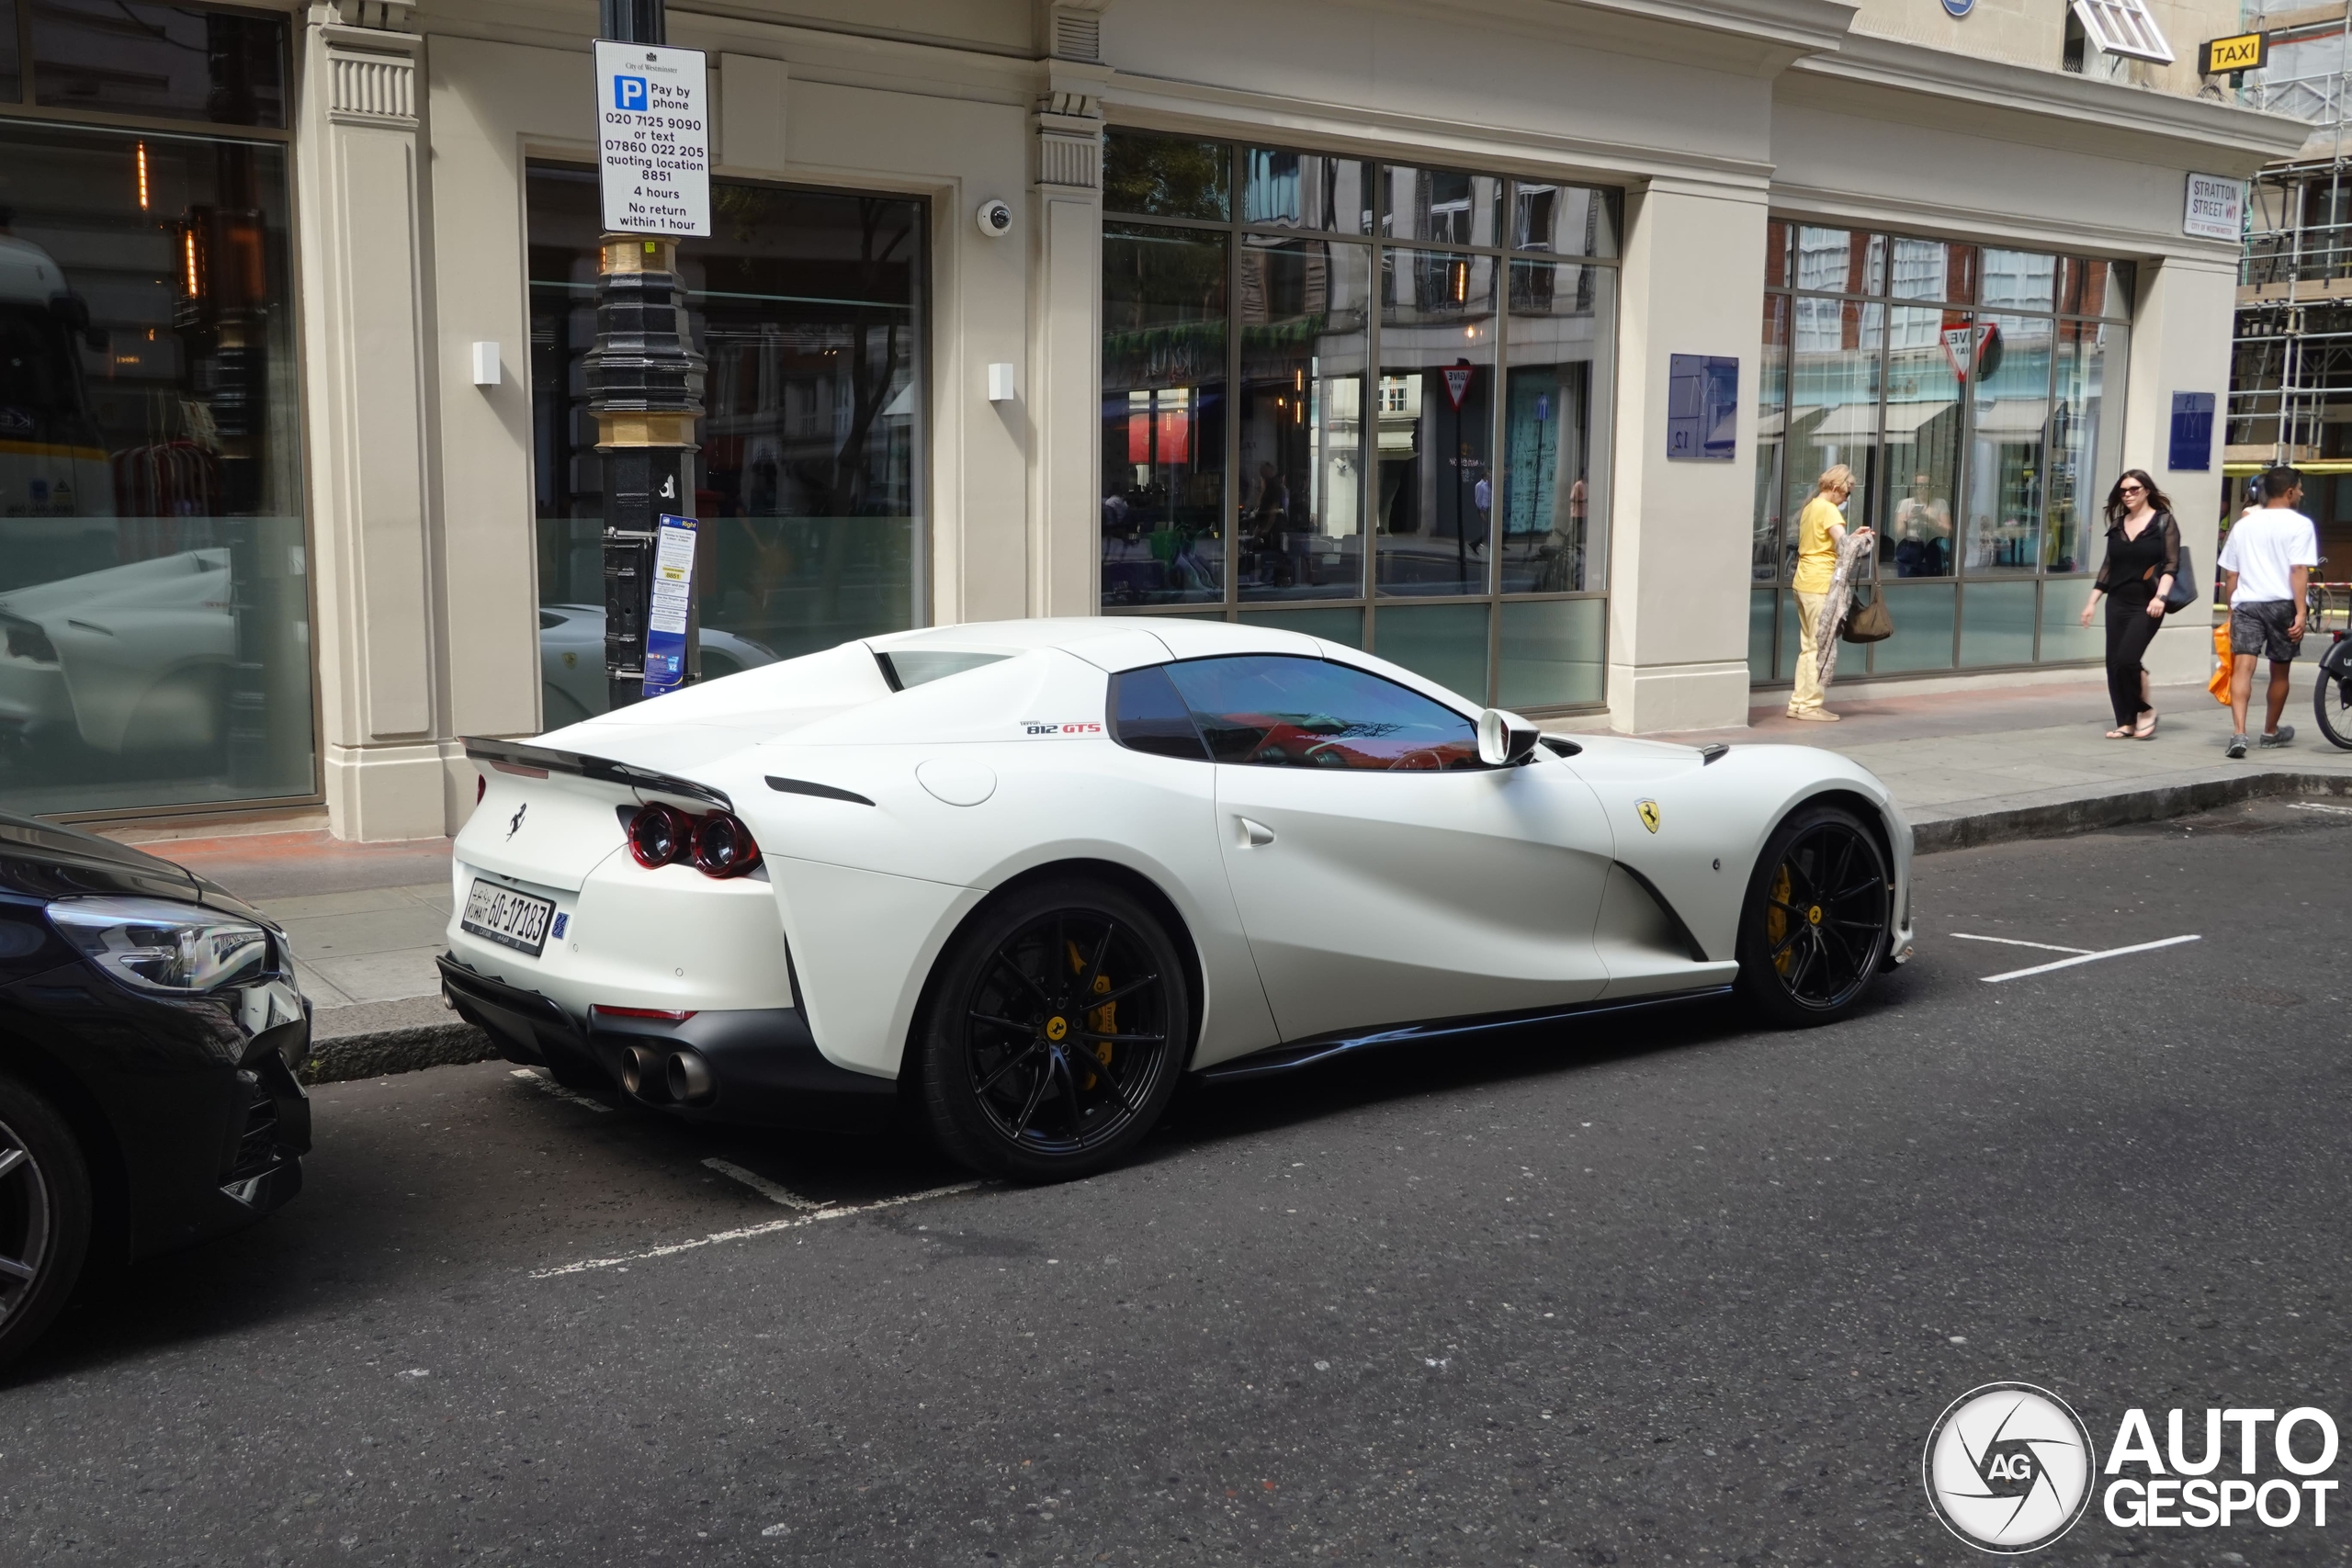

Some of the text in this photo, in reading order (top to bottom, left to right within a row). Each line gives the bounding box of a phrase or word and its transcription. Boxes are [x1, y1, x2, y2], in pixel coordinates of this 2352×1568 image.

[2213, 42, 2256, 64] TAXI
[626, 62, 637, 72] City
[645, 64, 678, 73] Westminster
[651, 84, 690, 98] Pay by
[653, 98, 689, 110] phone
[605, 112, 701, 130] 020 7125 9090
[650, 130, 675, 142] text
[605, 140, 704, 158] 07860 022 205
[606, 155, 704, 171] quoting location
[642, 170, 671, 182] 8851
[634, 186, 680, 199] 4 hours
[2195, 181, 2237, 201] STRATTON
[629, 202, 686, 216] No return
[2193, 199, 2237, 220] STREET W1
[619, 216, 695, 230] within 1 hour
[2191, 222, 2199, 231] CITY
[2207, 225, 2233, 235] WESTMINSTER
[671, 518, 696, 529] ParkRight
[1027, 723, 1101, 735] 812 GTS
[467, 903, 488, 924] KUWAIT
[487, 892, 548, 942] 60-17183
